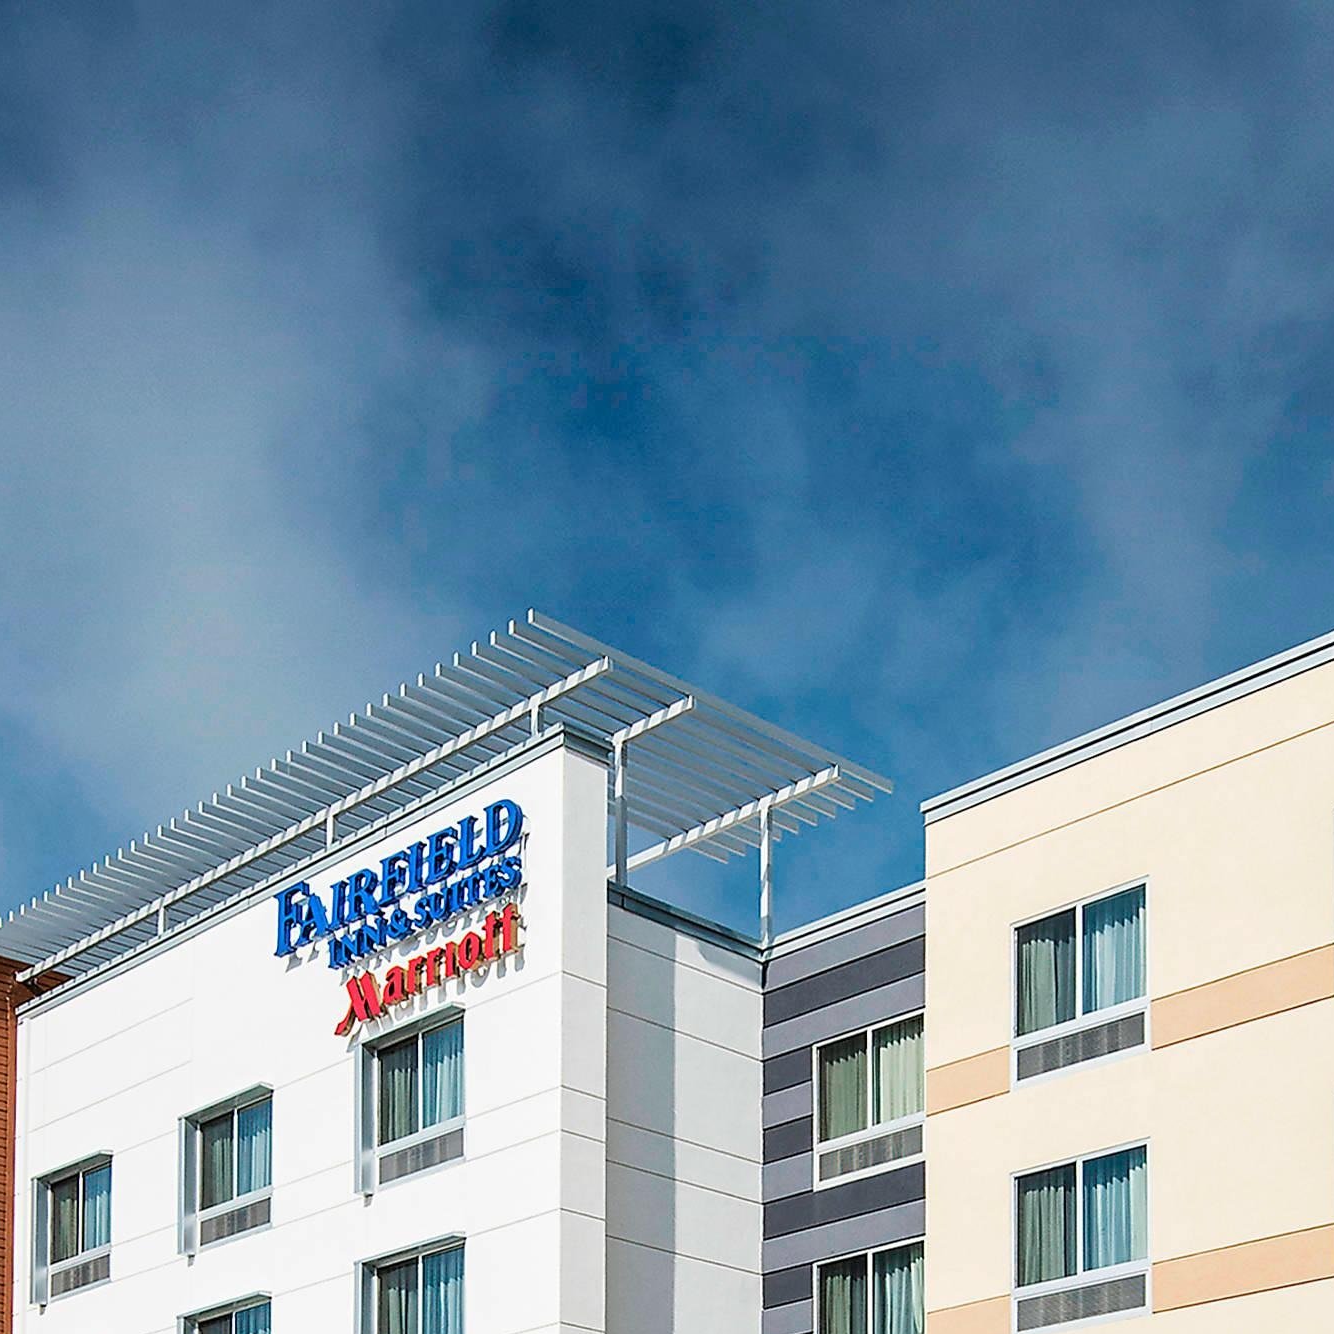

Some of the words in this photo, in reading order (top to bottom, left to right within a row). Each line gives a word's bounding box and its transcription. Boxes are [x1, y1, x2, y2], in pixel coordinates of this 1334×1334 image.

[273, 798, 525, 957] FAIRFIELD
[327, 915, 389, 970] INN
[388, 908, 413, 940] &
[413, 856, 524, 930] SUITES
[334, 902, 524, 1036] Marriott
